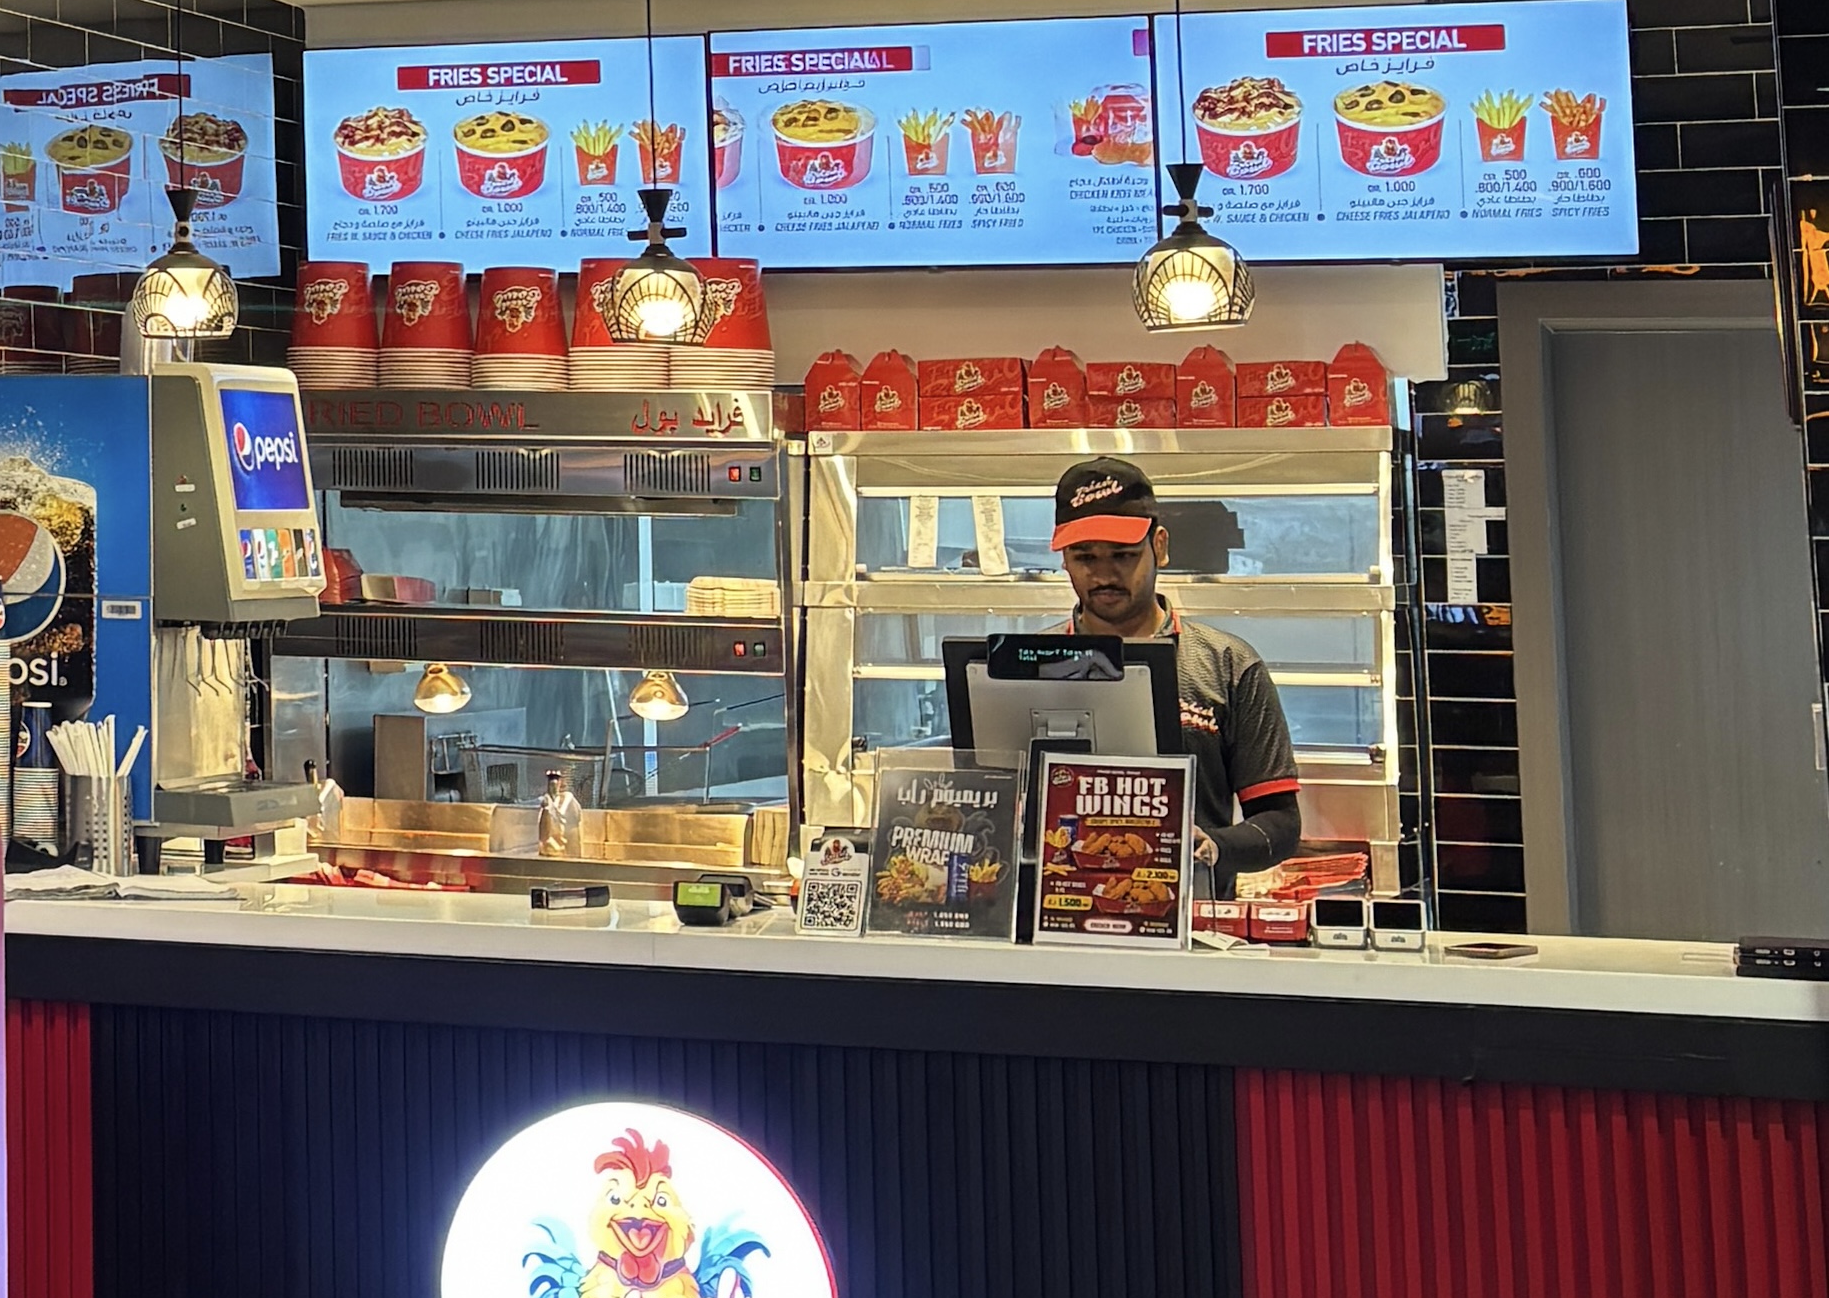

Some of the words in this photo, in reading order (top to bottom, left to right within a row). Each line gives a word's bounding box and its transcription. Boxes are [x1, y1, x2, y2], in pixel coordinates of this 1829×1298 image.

[1302, 33, 1366, 53] FRIES
[1371, 29, 1467, 52] SPECIAL
[427, 66, 482, 86] FRIES
[486, 64, 569, 85] SPECIAL
[1336, 58, 1379, 76] خاص
[1382, 56, 1435, 75] فرايز
[456, 89, 492, 106] خاص
[496, 88, 540, 105] فرايز
[1240, 184, 1269, 195] 1.700
[1385, 180, 1416, 192] 1.000
[308, 399, 404, 427] RIED
[417, 401, 540, 430] BOWL
[254, 431, 298, 471] pepsi
[897, 778, 927, 805] راب
[1078, 776, 1110, 795] FB
[1116, 777, 1167, 796] HOT
[930, 788, 999, 808] بريميوم
[1075, 795, 1169, 817] WINGS
[891, 825, 975, 854] PREMIUM
